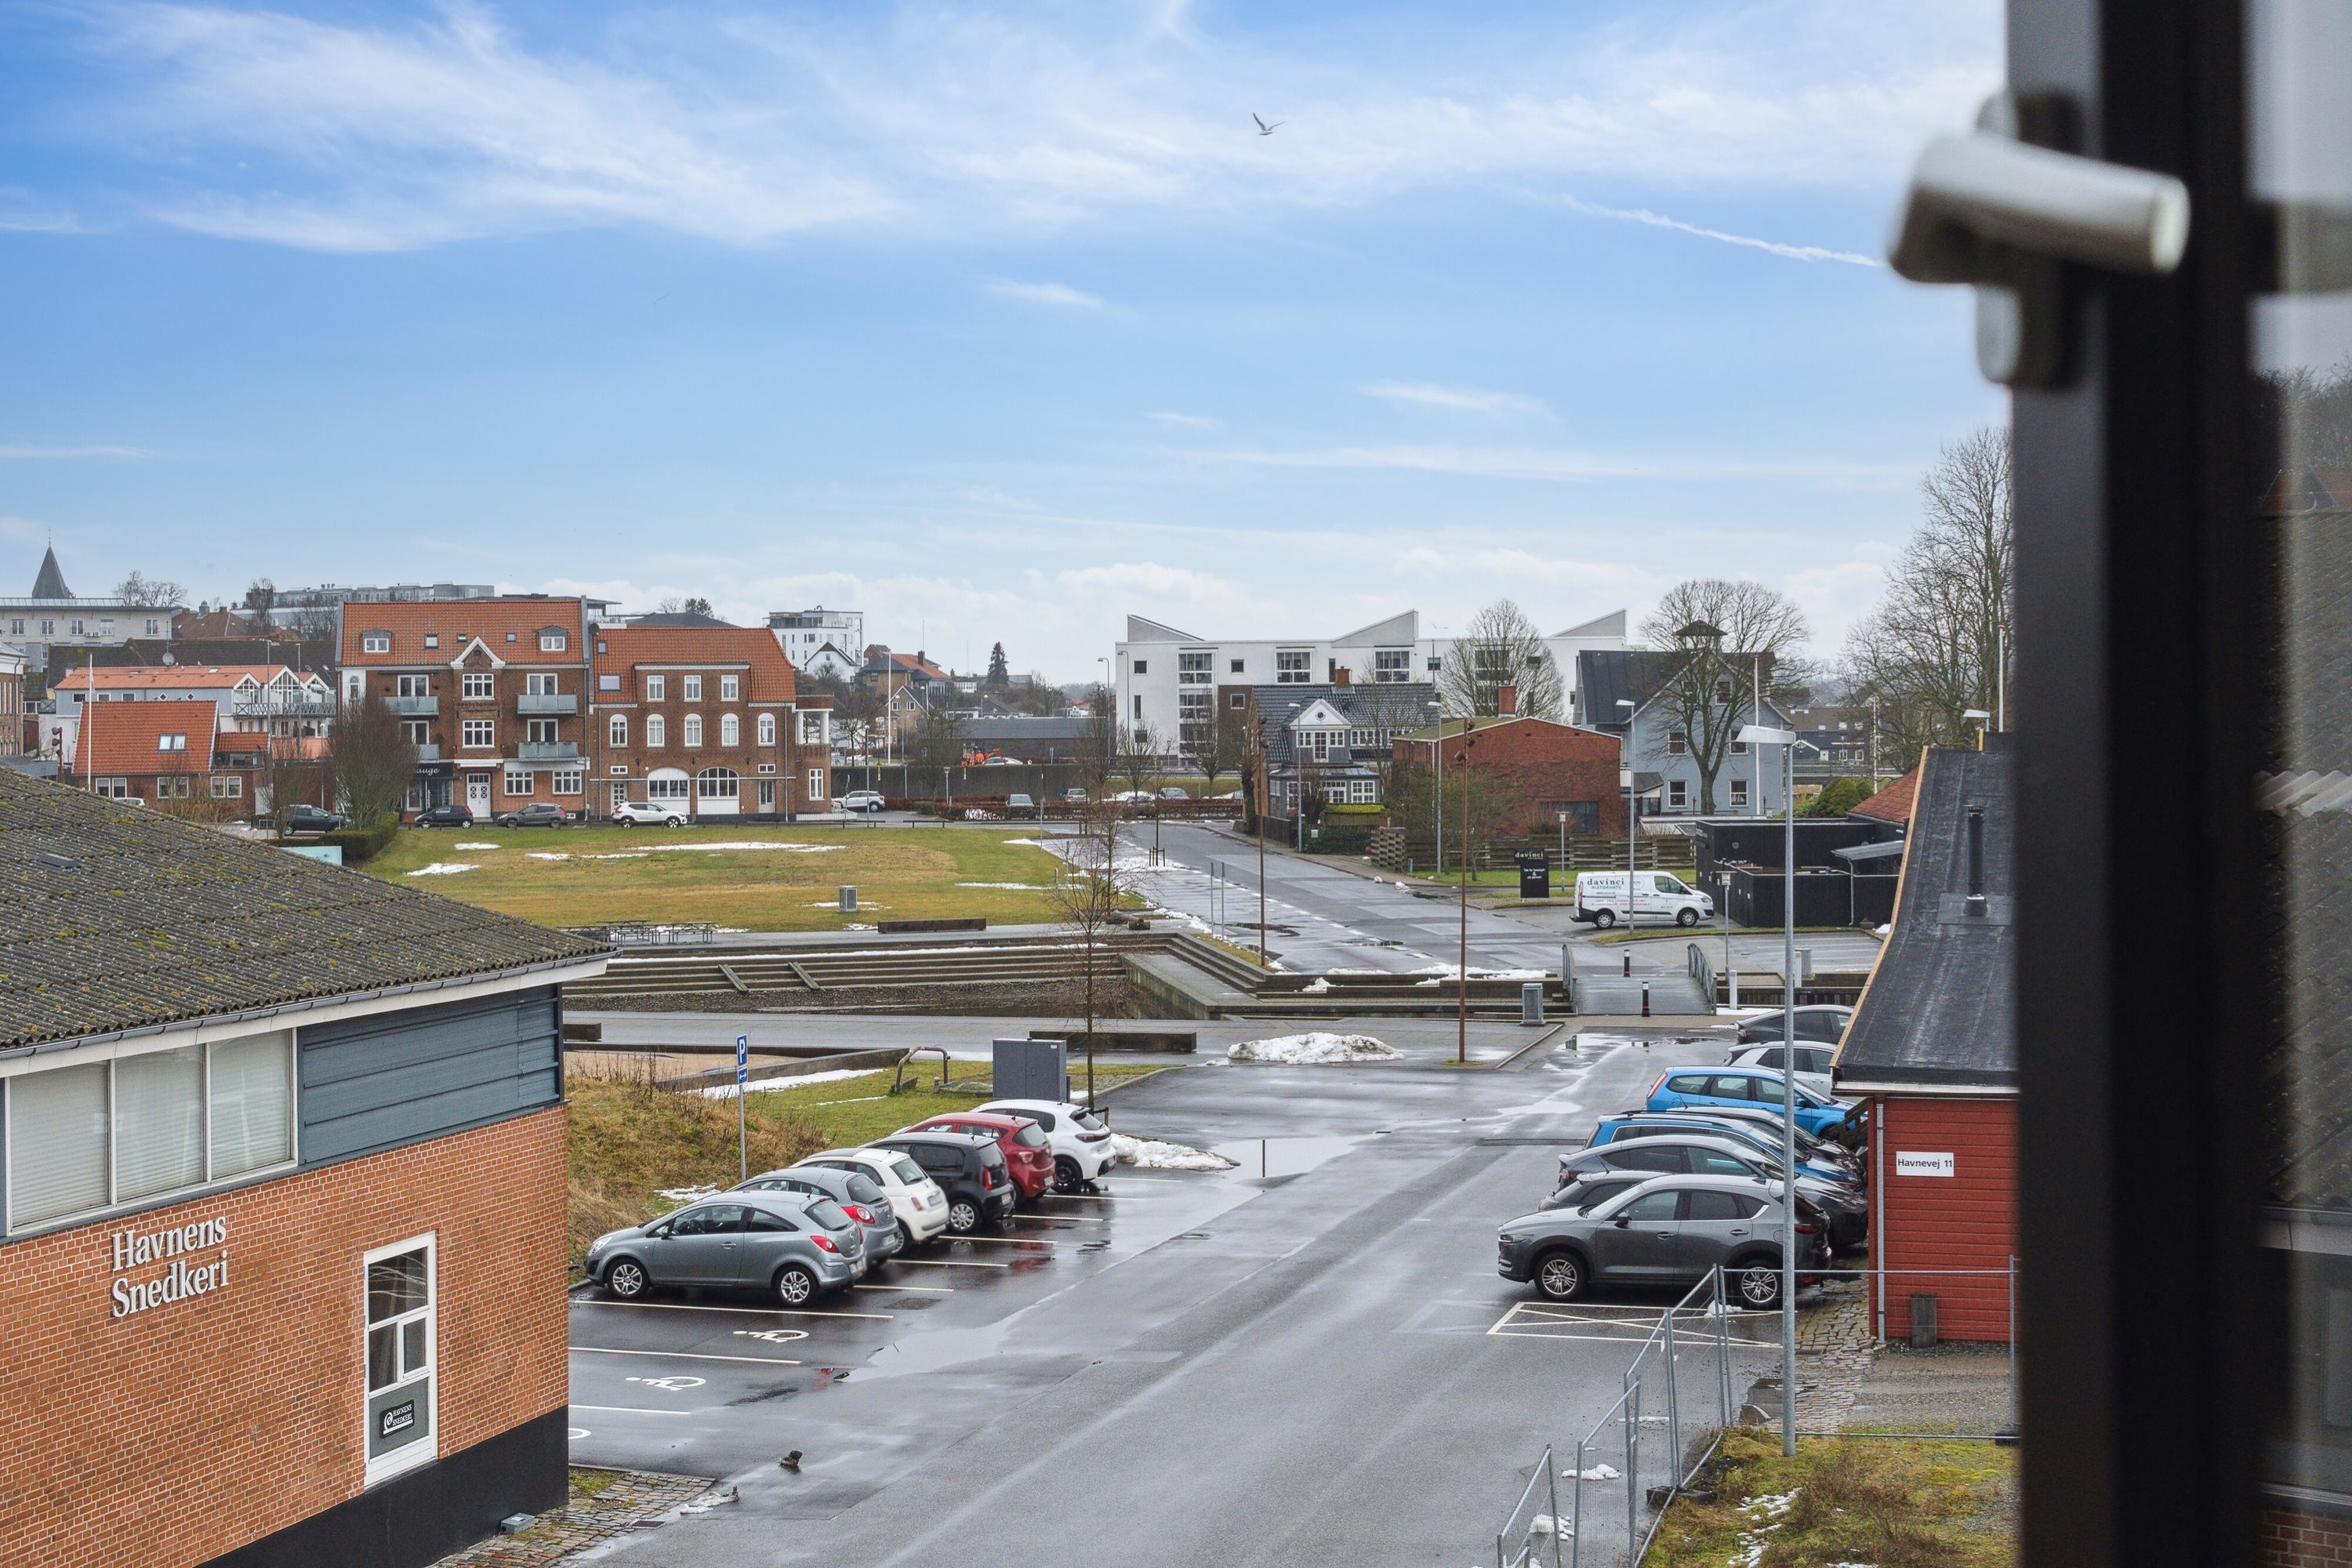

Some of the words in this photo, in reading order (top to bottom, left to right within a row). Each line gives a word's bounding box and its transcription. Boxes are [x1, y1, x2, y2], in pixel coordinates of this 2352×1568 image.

[739, 1039, 746, 1065] P
[1897, 1159, 1940, 1170] Havnevej
[1944, 1160, 1953, 1168] 11
[111, 1216, 227, 1272] Havnens
[112, 1250, 229, 1318] Snedkeri
